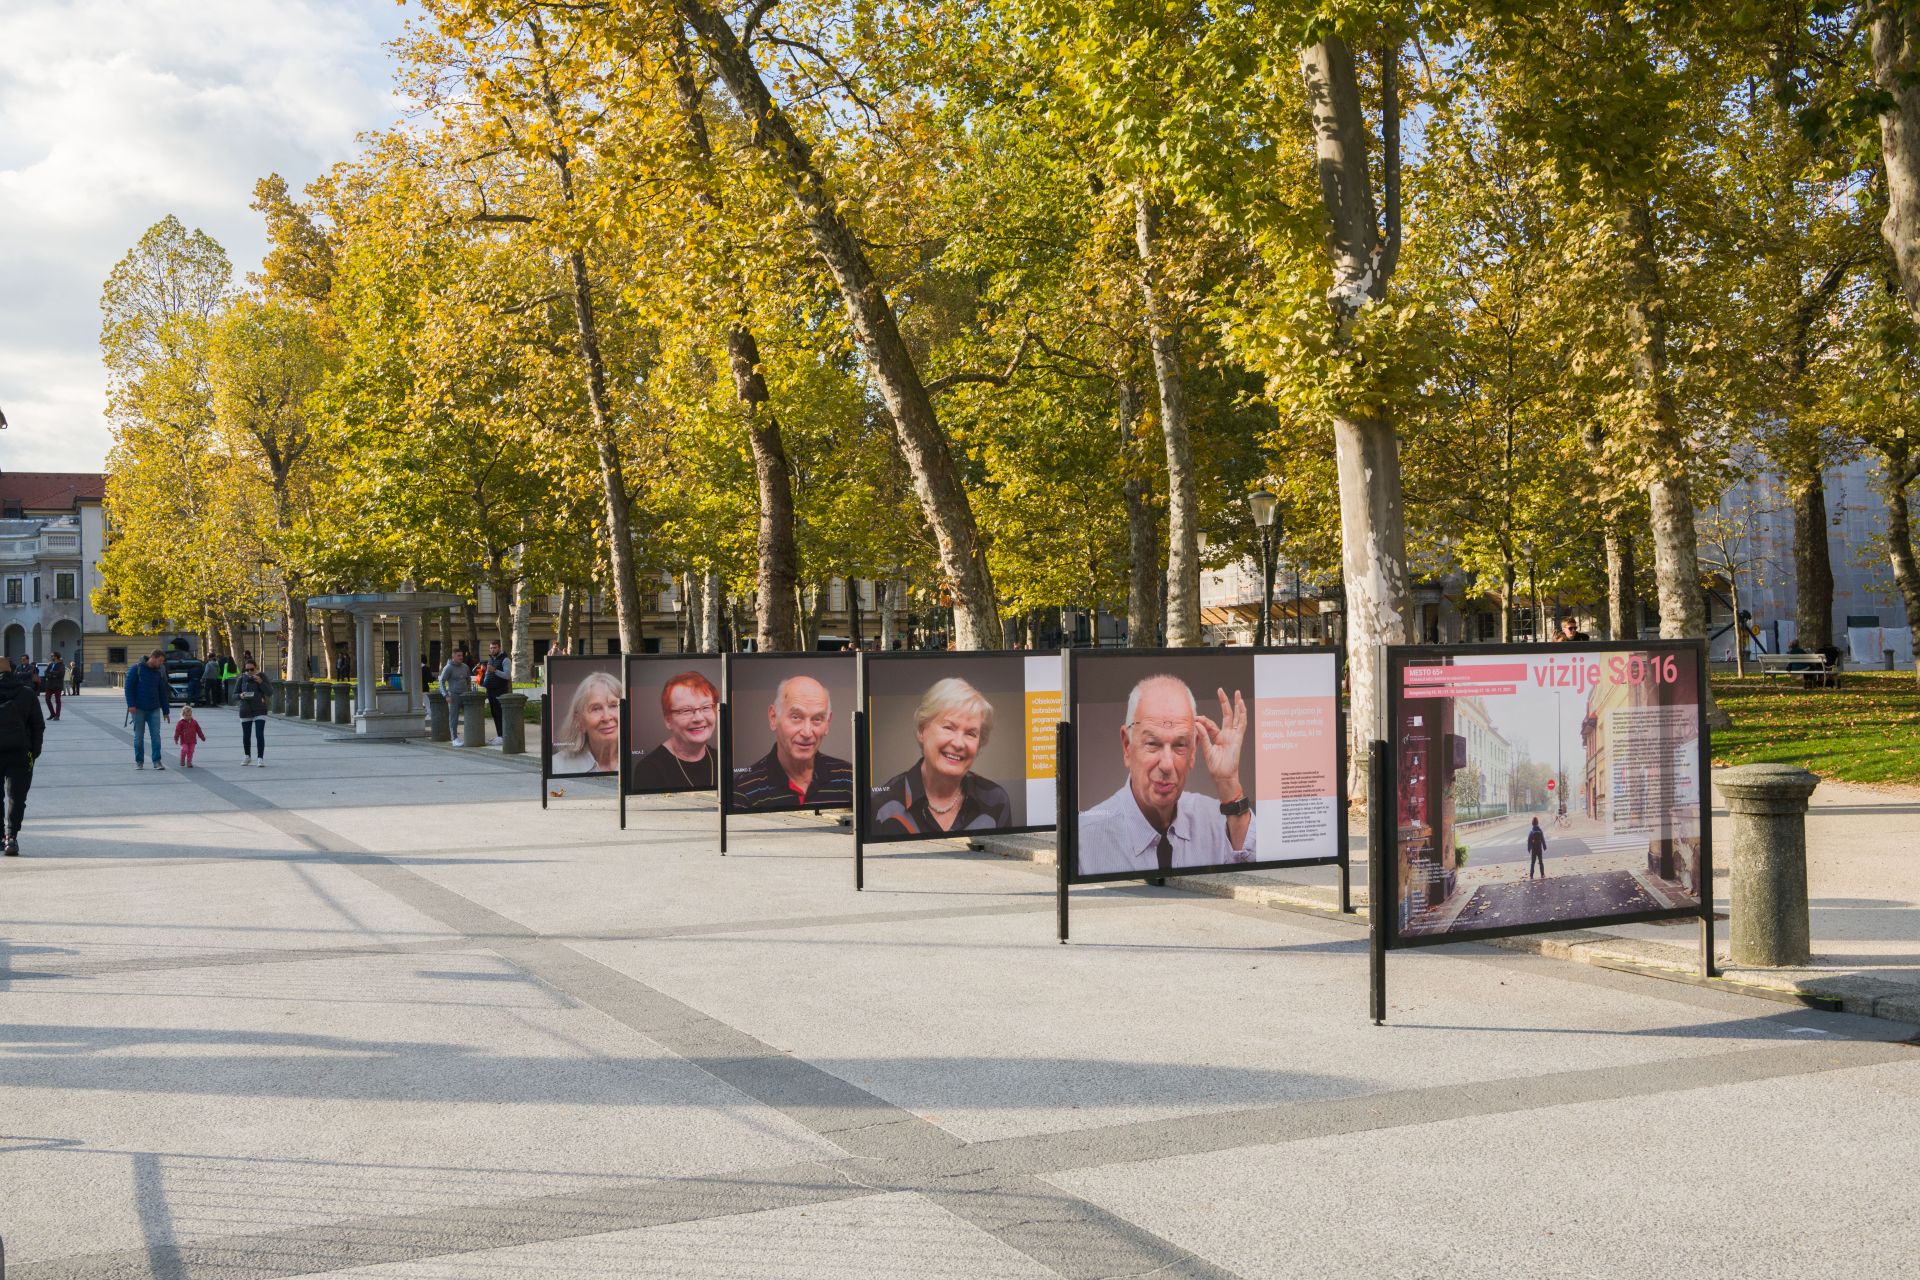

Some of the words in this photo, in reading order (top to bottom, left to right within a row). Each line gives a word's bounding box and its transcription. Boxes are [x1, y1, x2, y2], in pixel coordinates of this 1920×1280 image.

[1409, 668, 1431, 677] MESTO
[1533, 656, 1601, 694] vizije
[1608, 655, 1645, 686] SO
[1650, 654, 1678, 684] 16
